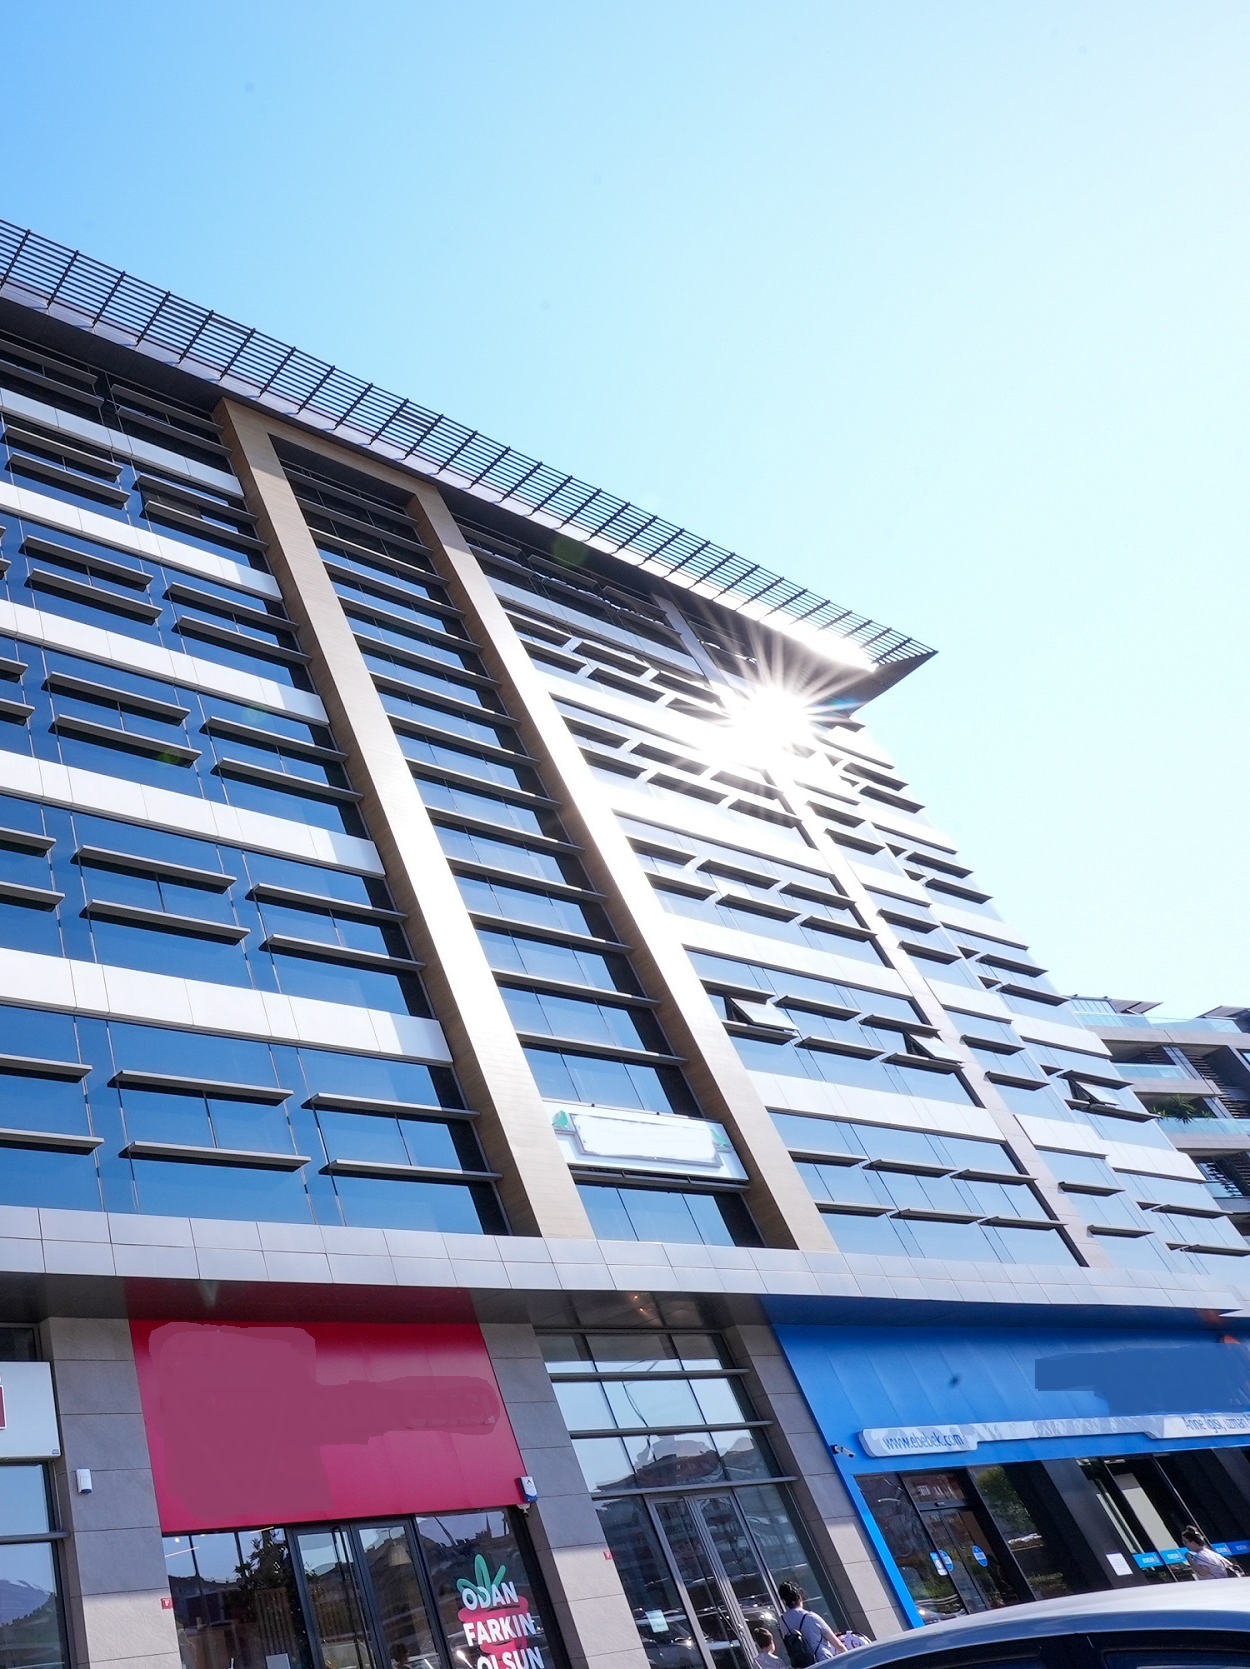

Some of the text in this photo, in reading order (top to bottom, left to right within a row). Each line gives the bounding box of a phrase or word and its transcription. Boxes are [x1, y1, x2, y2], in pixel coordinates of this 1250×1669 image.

[882, 1431, 965, 1450] www.ebebek.com
[462, 1581, 519, 1611] ODAN
[463, 1612, 537, 1647] FARKIN
